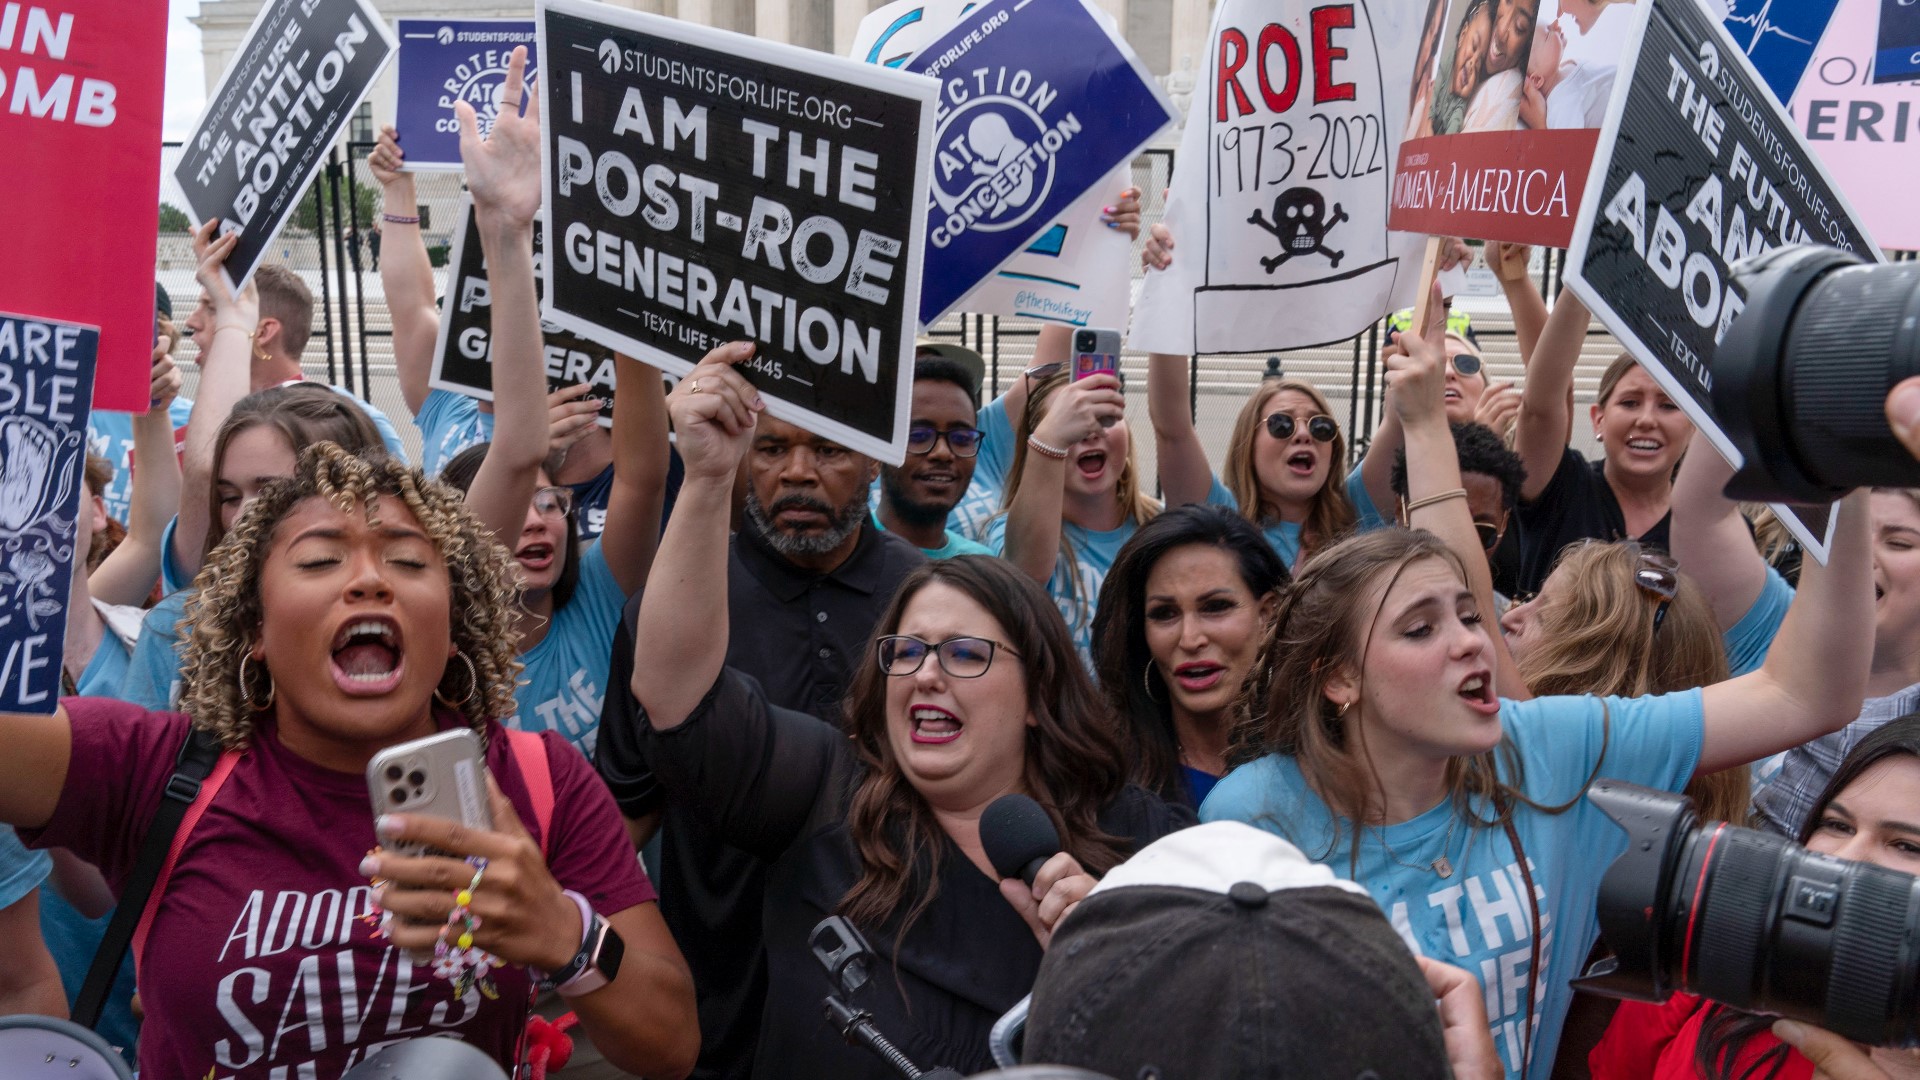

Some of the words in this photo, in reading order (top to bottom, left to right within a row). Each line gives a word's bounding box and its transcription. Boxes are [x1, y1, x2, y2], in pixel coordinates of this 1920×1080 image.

[922, 9, 1010, 79] SFORLIFE.ORG
[1216, 4, 1356, 122] ROE
[197, 130, 232, 187] THE
[231, 17, 302, 132] FUTURE
[220, 12, 369, 238] ABORTION
[234, 49, 310, 181] ANTI-
[468, 83, 494, 103] AT
[624, 49, 852, 130] STUDENTSFORLIFE.ORG
[936, 66, 1058, 124] ECTION
[571, 71, 583, 125] I
[613, 86, 708, 161] AM
[742, 117, 879, 212] THE
[931, 112, 1082, 249] CONCEPTION
[938, 134, 975, 182] AT
[1217, 113, 1383, 197] 1973-2022
[1667, 53, 1726, 158] THE
[1729, 141, 1813, 247] FUTU
[558, 134, 903, 305] POST-ROE
[1440, 161, 1570, 218] AMERICA
[565, 221, 881, 384] GENERATION
[642, 310, 675, 336] TEXT
[678, 325, 708, 351] LIFE
[1670, 330, 1699, 374] TEXT
[217, 885, 390, 963] ADOP
